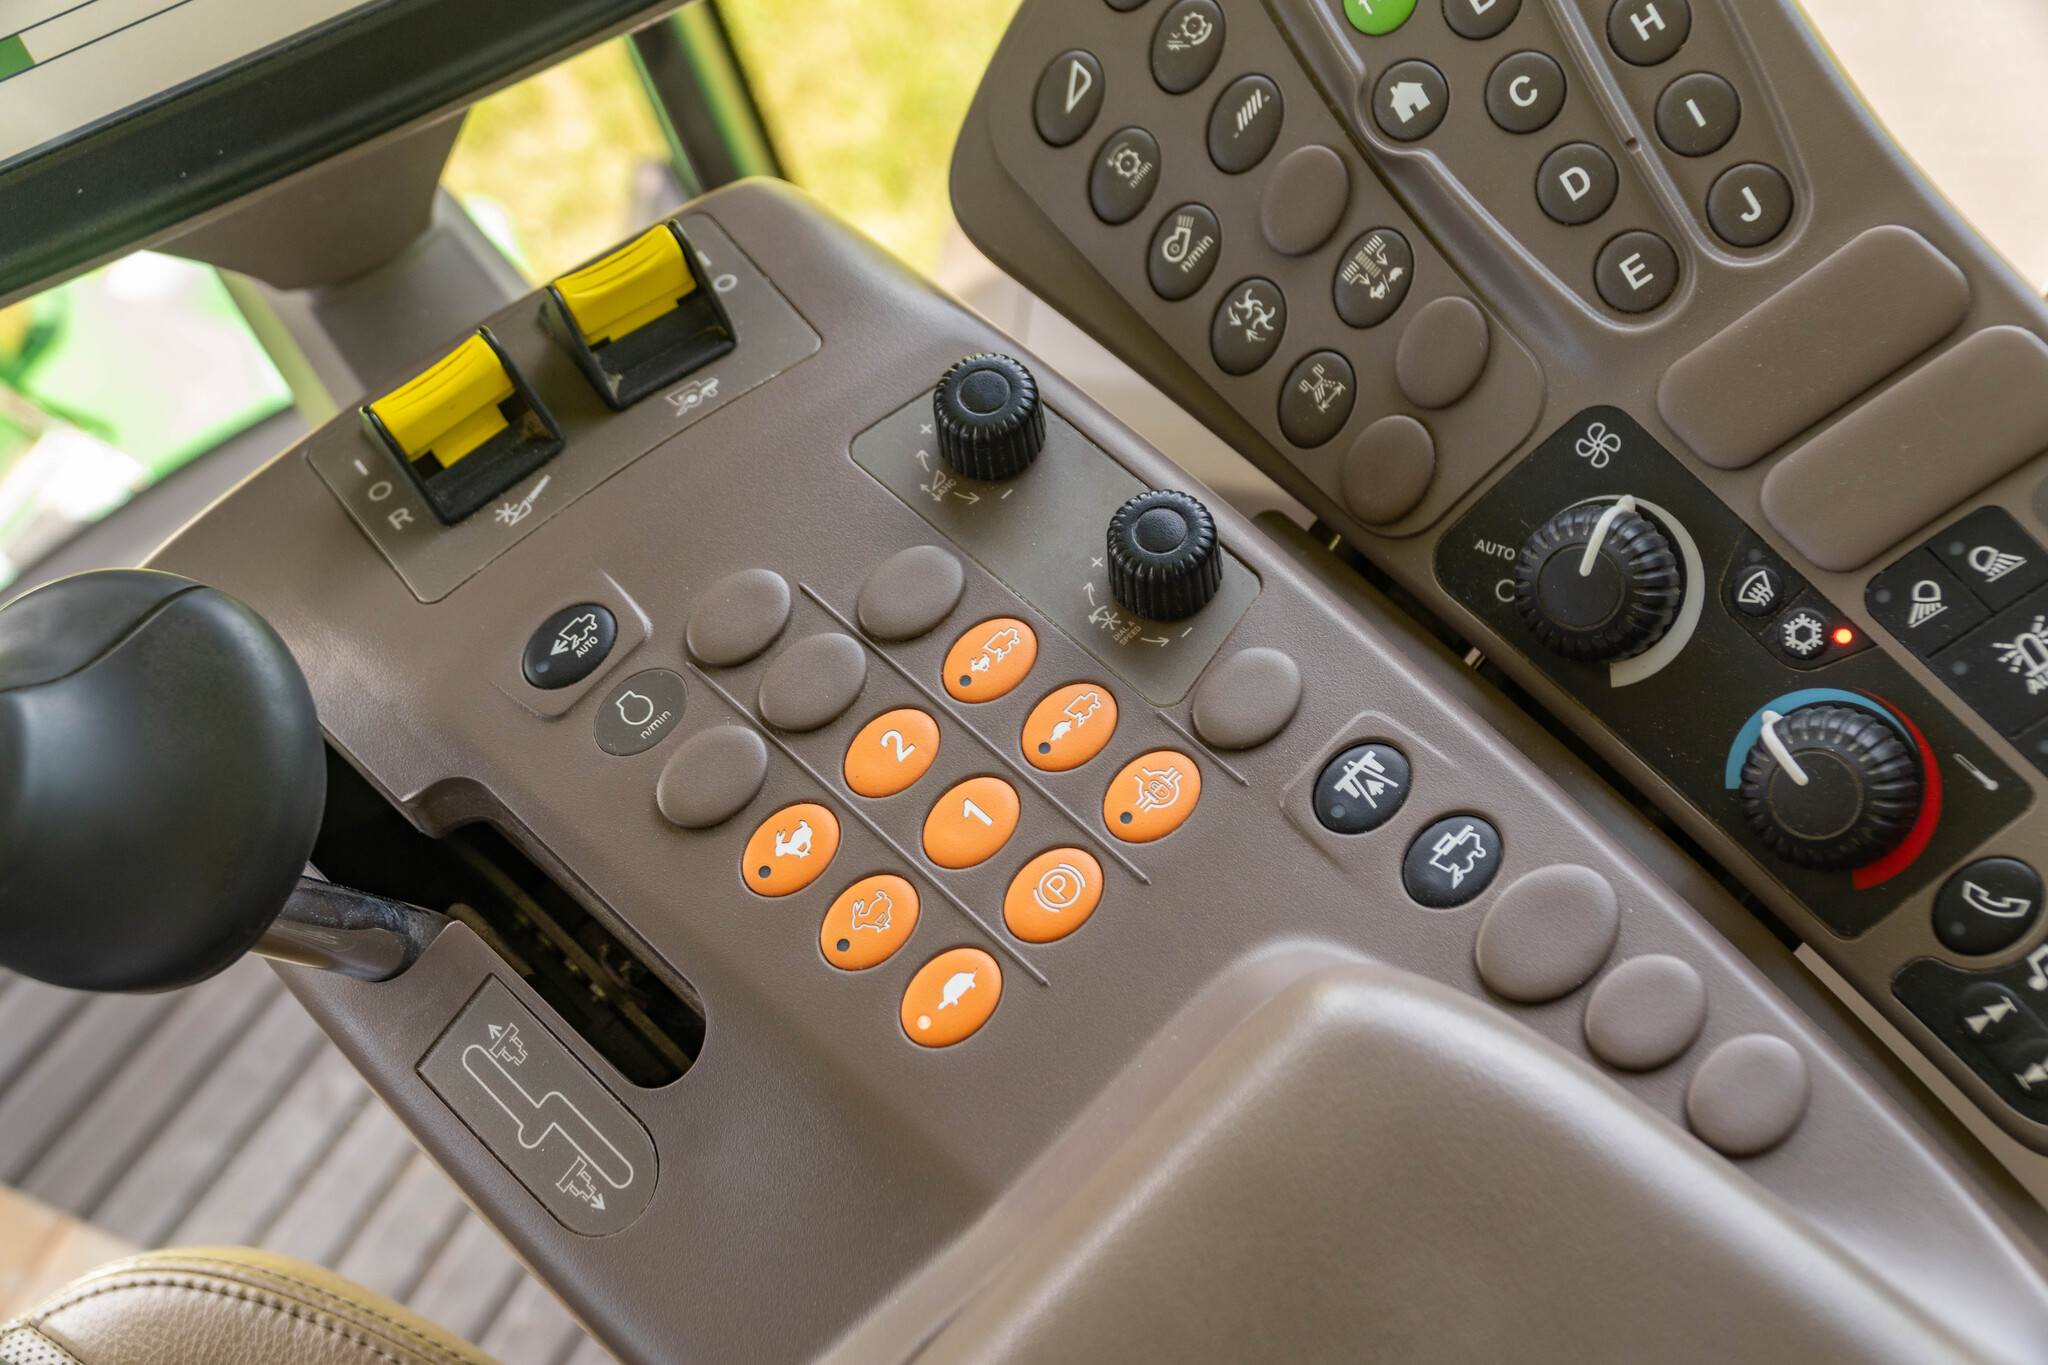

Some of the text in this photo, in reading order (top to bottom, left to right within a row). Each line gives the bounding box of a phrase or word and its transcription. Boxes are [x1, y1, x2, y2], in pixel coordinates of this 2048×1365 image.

[1630, 2, 1666, 41] H
[1509, 75, 1538, 107] C
[1559, 166, 1591, 201] D
[1740, 186, 1762, 222] J
[1181, 235, 1214, 272] n/min
[1619, 252, 1654, 290] E
[388, 507, 415, 531] R
[1474, 538, 1516, 561] AUTO
[575, 635, 599, 659] AUTO
[639, 709, 672, 740] n/min
[880, 730, 916, 763] 2
[963, 798, 994, 827] 1
